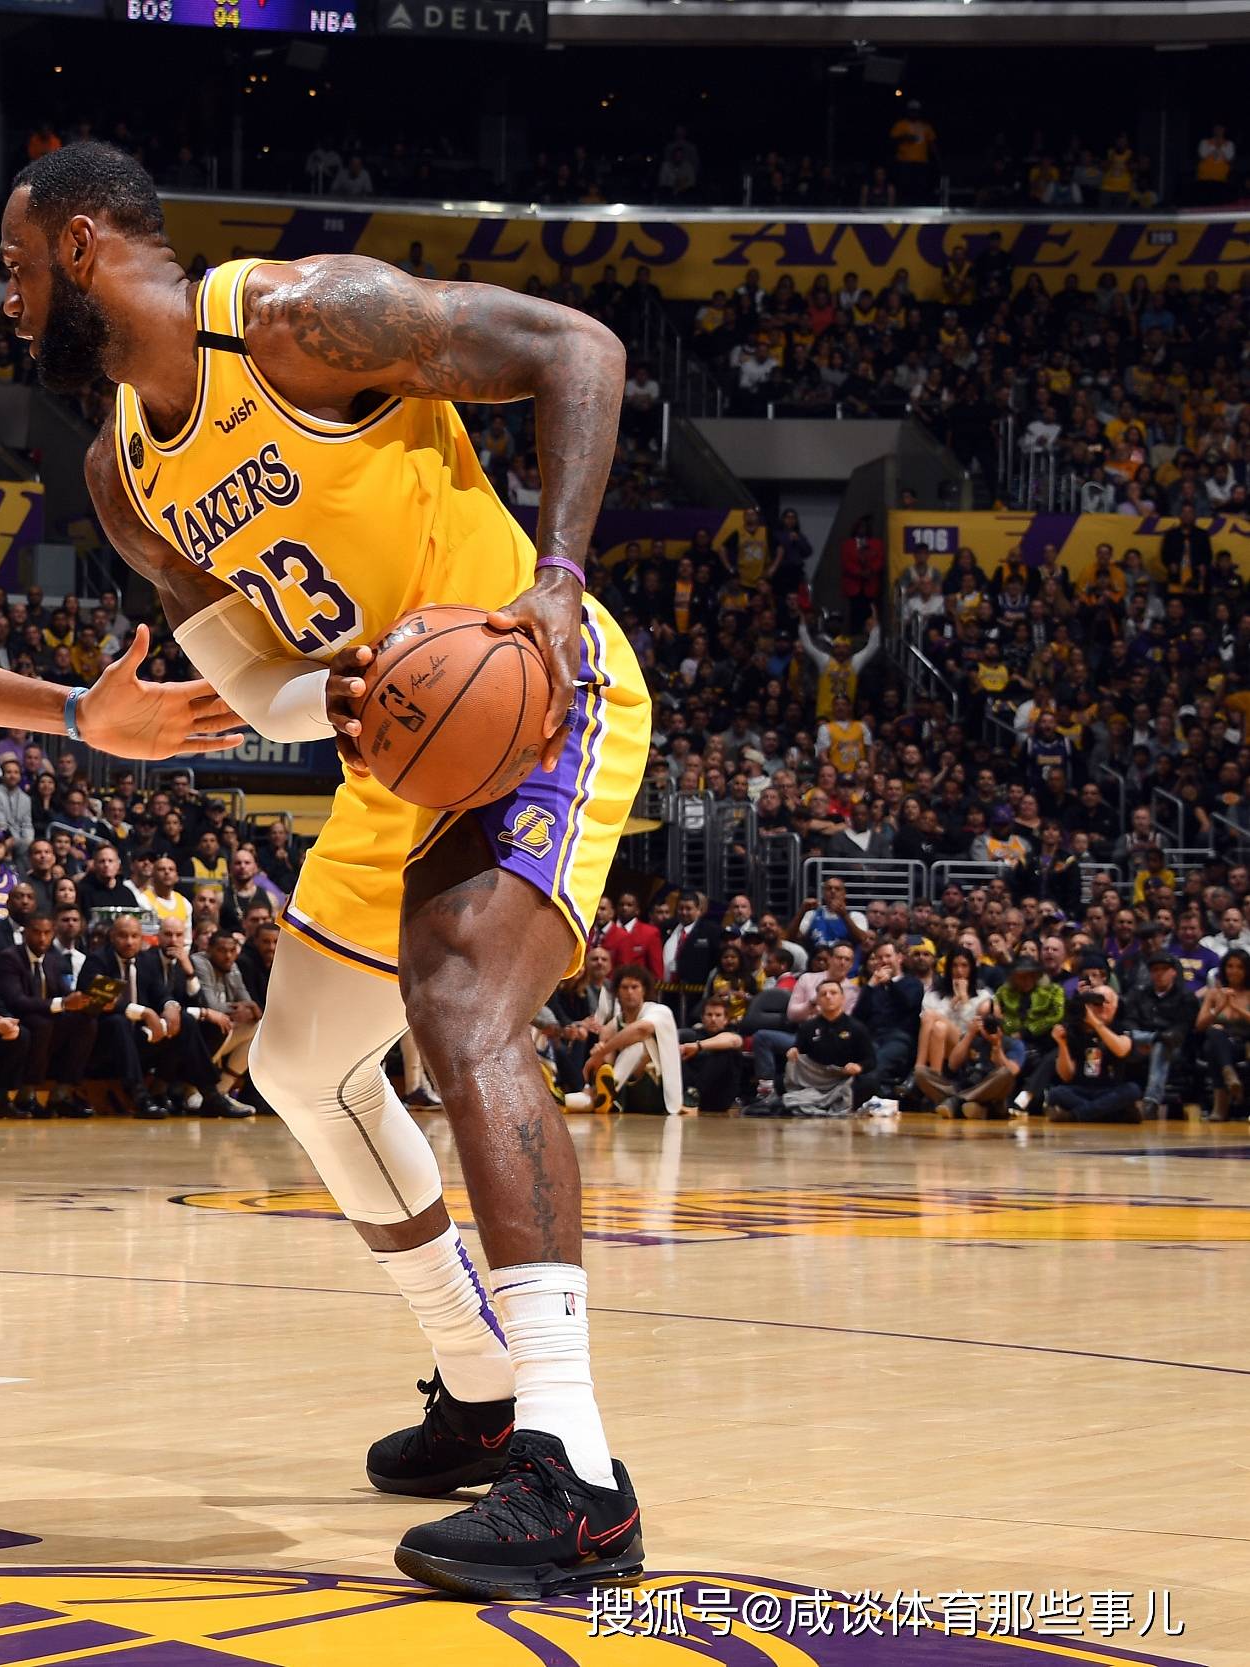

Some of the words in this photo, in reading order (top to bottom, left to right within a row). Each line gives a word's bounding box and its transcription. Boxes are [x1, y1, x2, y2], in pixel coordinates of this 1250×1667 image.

[127, 0, 173, 22] BOS
[213, 7, 241, 28] 94
[310, 11, 357, 33] NBA
[423, 7, 535, 33] DELTA
[215, 397, 257, 434] wish
[160, 441, 302, 572] LAKERS
[225, 537, 364, 658] 23
